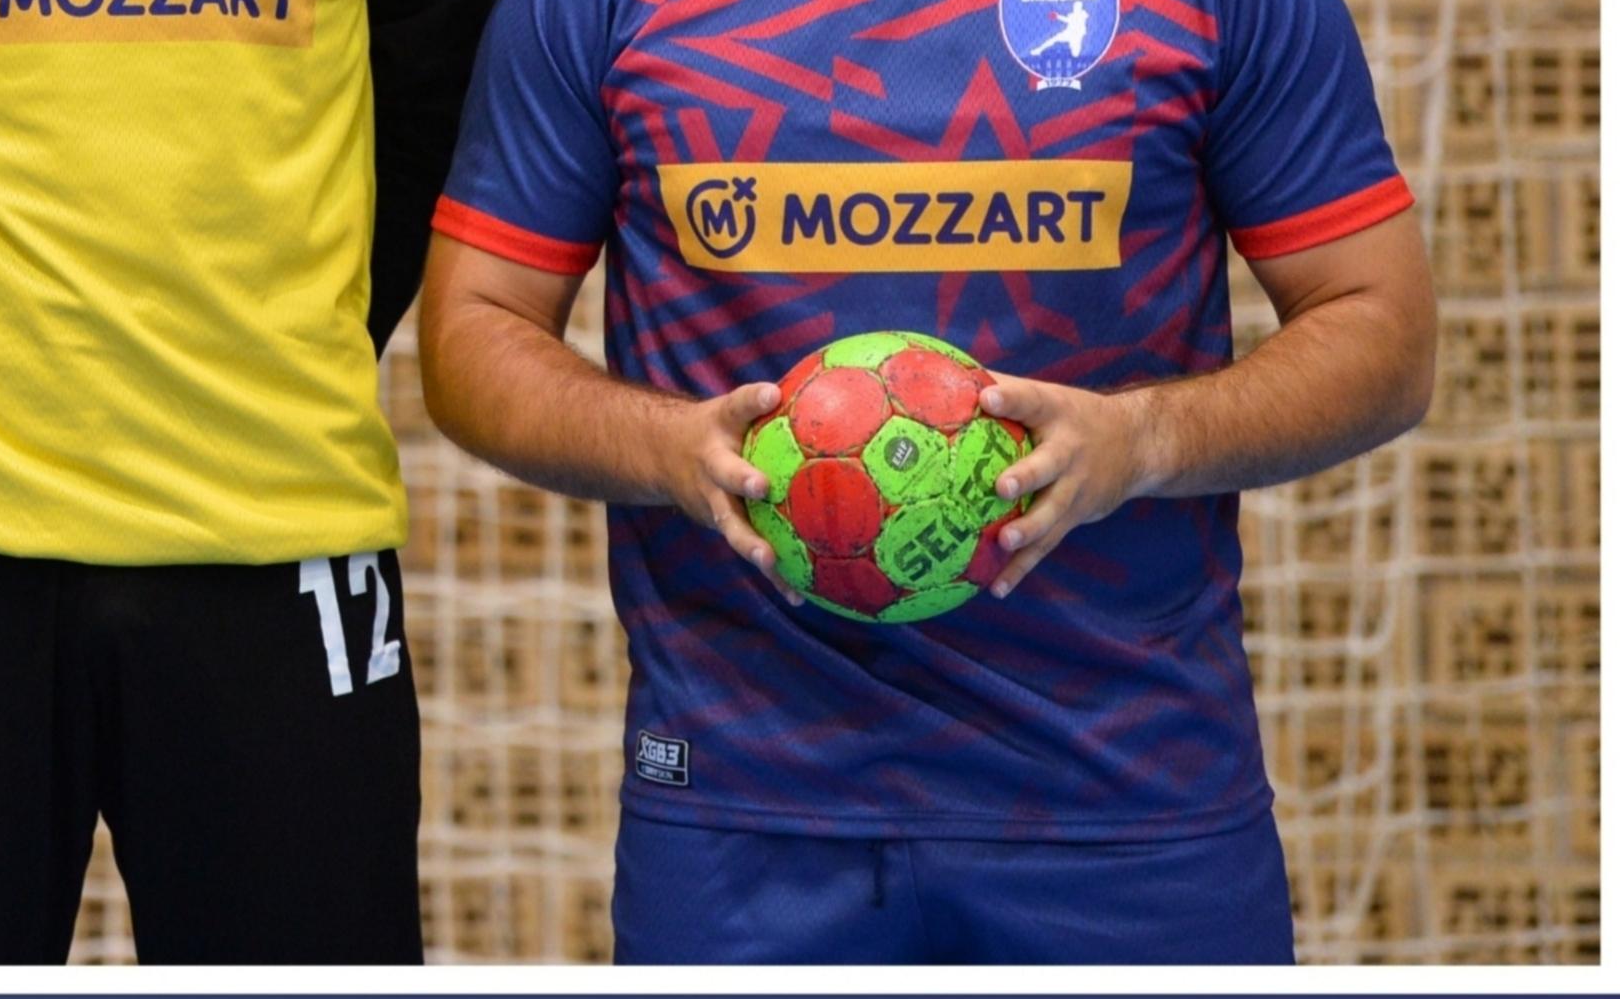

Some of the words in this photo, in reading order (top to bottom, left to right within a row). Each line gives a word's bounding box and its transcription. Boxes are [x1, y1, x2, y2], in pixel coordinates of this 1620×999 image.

[780, 191, 1106, 246] MOZZART
[891, 440, 912, 466] EHF
[892, 426, 1014, 582] SELECT
[298, 552, 402, 697] 12
